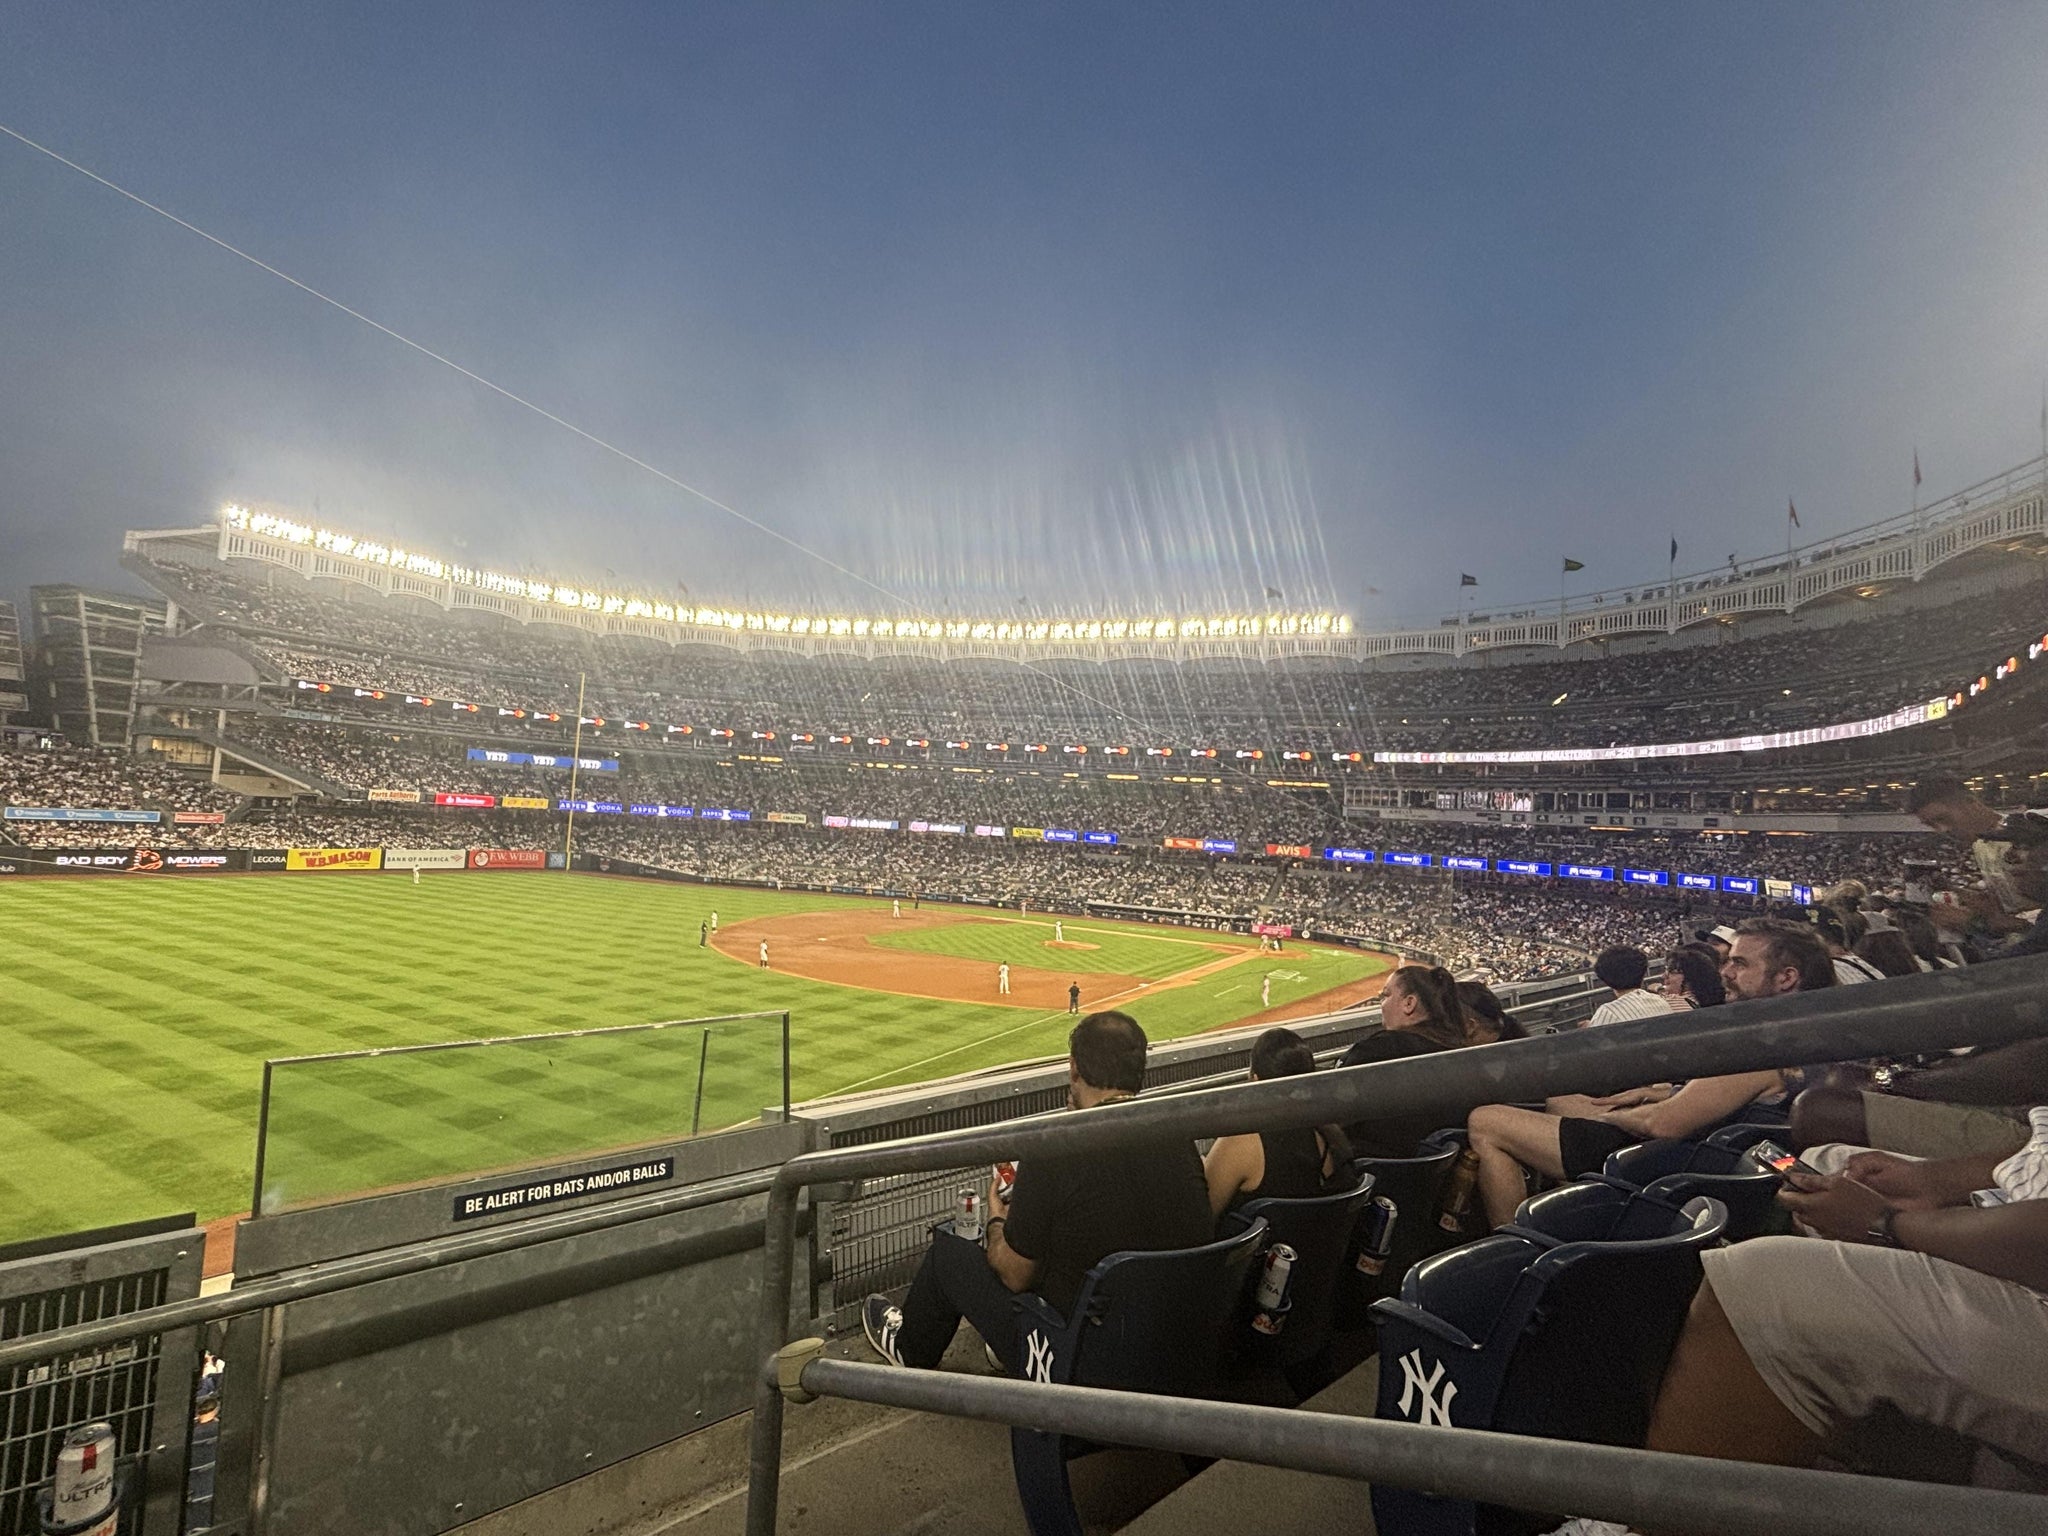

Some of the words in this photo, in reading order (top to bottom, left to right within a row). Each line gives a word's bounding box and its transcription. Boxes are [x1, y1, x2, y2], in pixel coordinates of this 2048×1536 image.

[486, 751, 509, 762] YETI
[533, 755, 556, 766] YETI
[579, 759, 602, 770] YETI
[371, 791, 388, 799] Parts
[389, 792, 418, 801] Authority
[632, 806, 658, 814] ASPEN
[667, 808, 692, 816] VODKA
[729, 812, 750, 820] VODKA
[1275, 845, 1301, 856] AVIS
[56, 856, 91, 865] BAD
[95, 856, 128, 865] BOY
[167, 856, 227, 865] MOWERS
[253, 856, 287, 864] LEGORA
[509, 852, 539, 861] WEBB
[1459, 859, 1483, 869] roadway
[1579, 868, 1604, 879] roadway
[465, 1196, 483, 1214] BE
[485, 1189, 526, 1210] ALERT
[527, 1186, 551, 1202] FOR
[554, 1178, 585, 1197] BATS
[586, 1169, 631, 1190] AND/OR
[633, 1163, 667, 1181] BALLS
[59, 1476, 113, 1503] ULTRA
